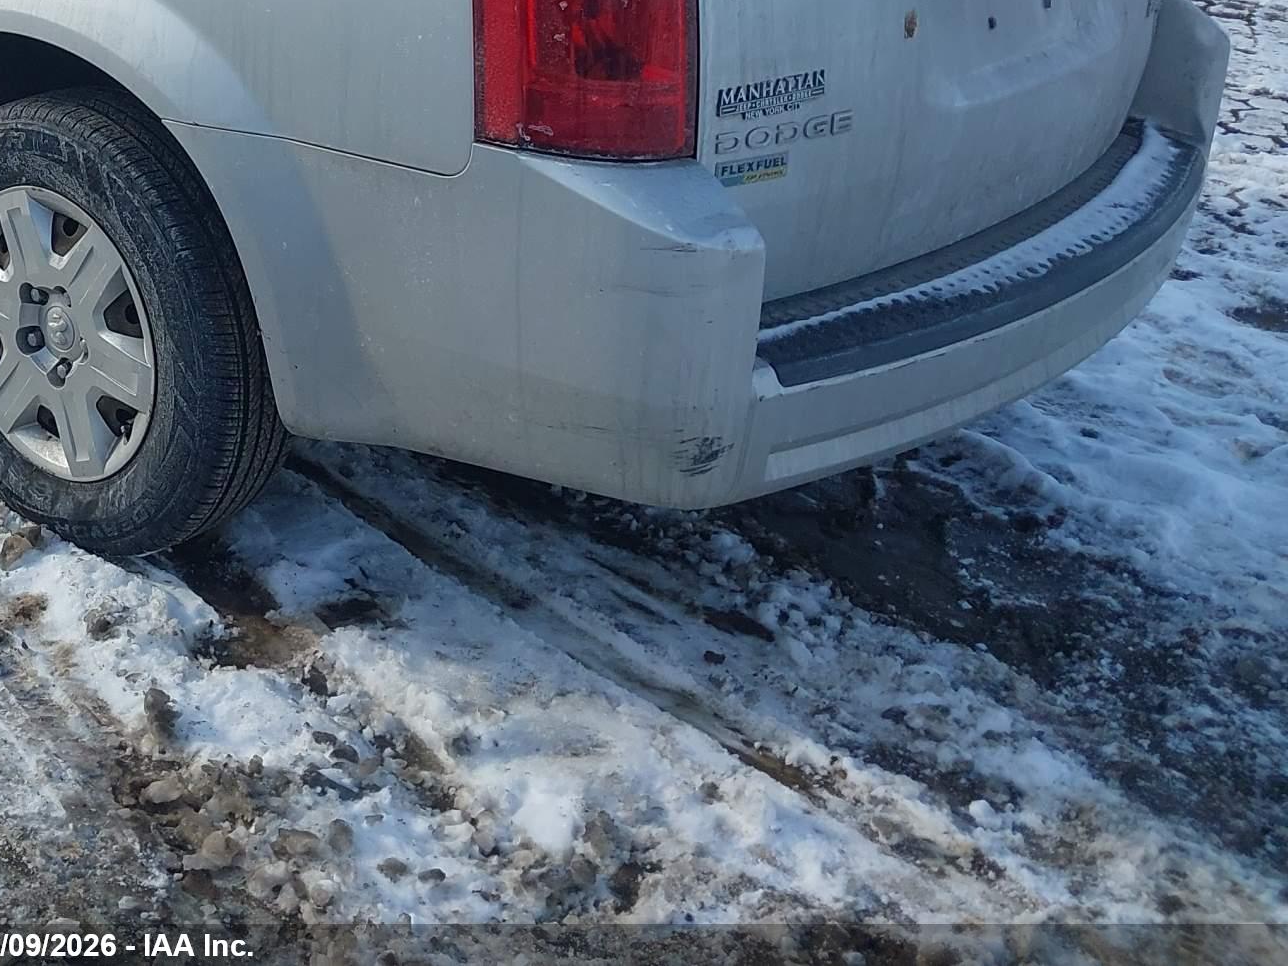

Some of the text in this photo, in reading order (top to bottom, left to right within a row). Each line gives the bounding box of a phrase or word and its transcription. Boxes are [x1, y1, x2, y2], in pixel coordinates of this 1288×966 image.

[718, 70, 825, 106] MANHATTAN
[745, 109, 762, 122] NEW
[764, 104, 785, 116] YORK
[715, 108, 855, 154] DODGE
[721, 156, 788, 177] FLEXFUEL
